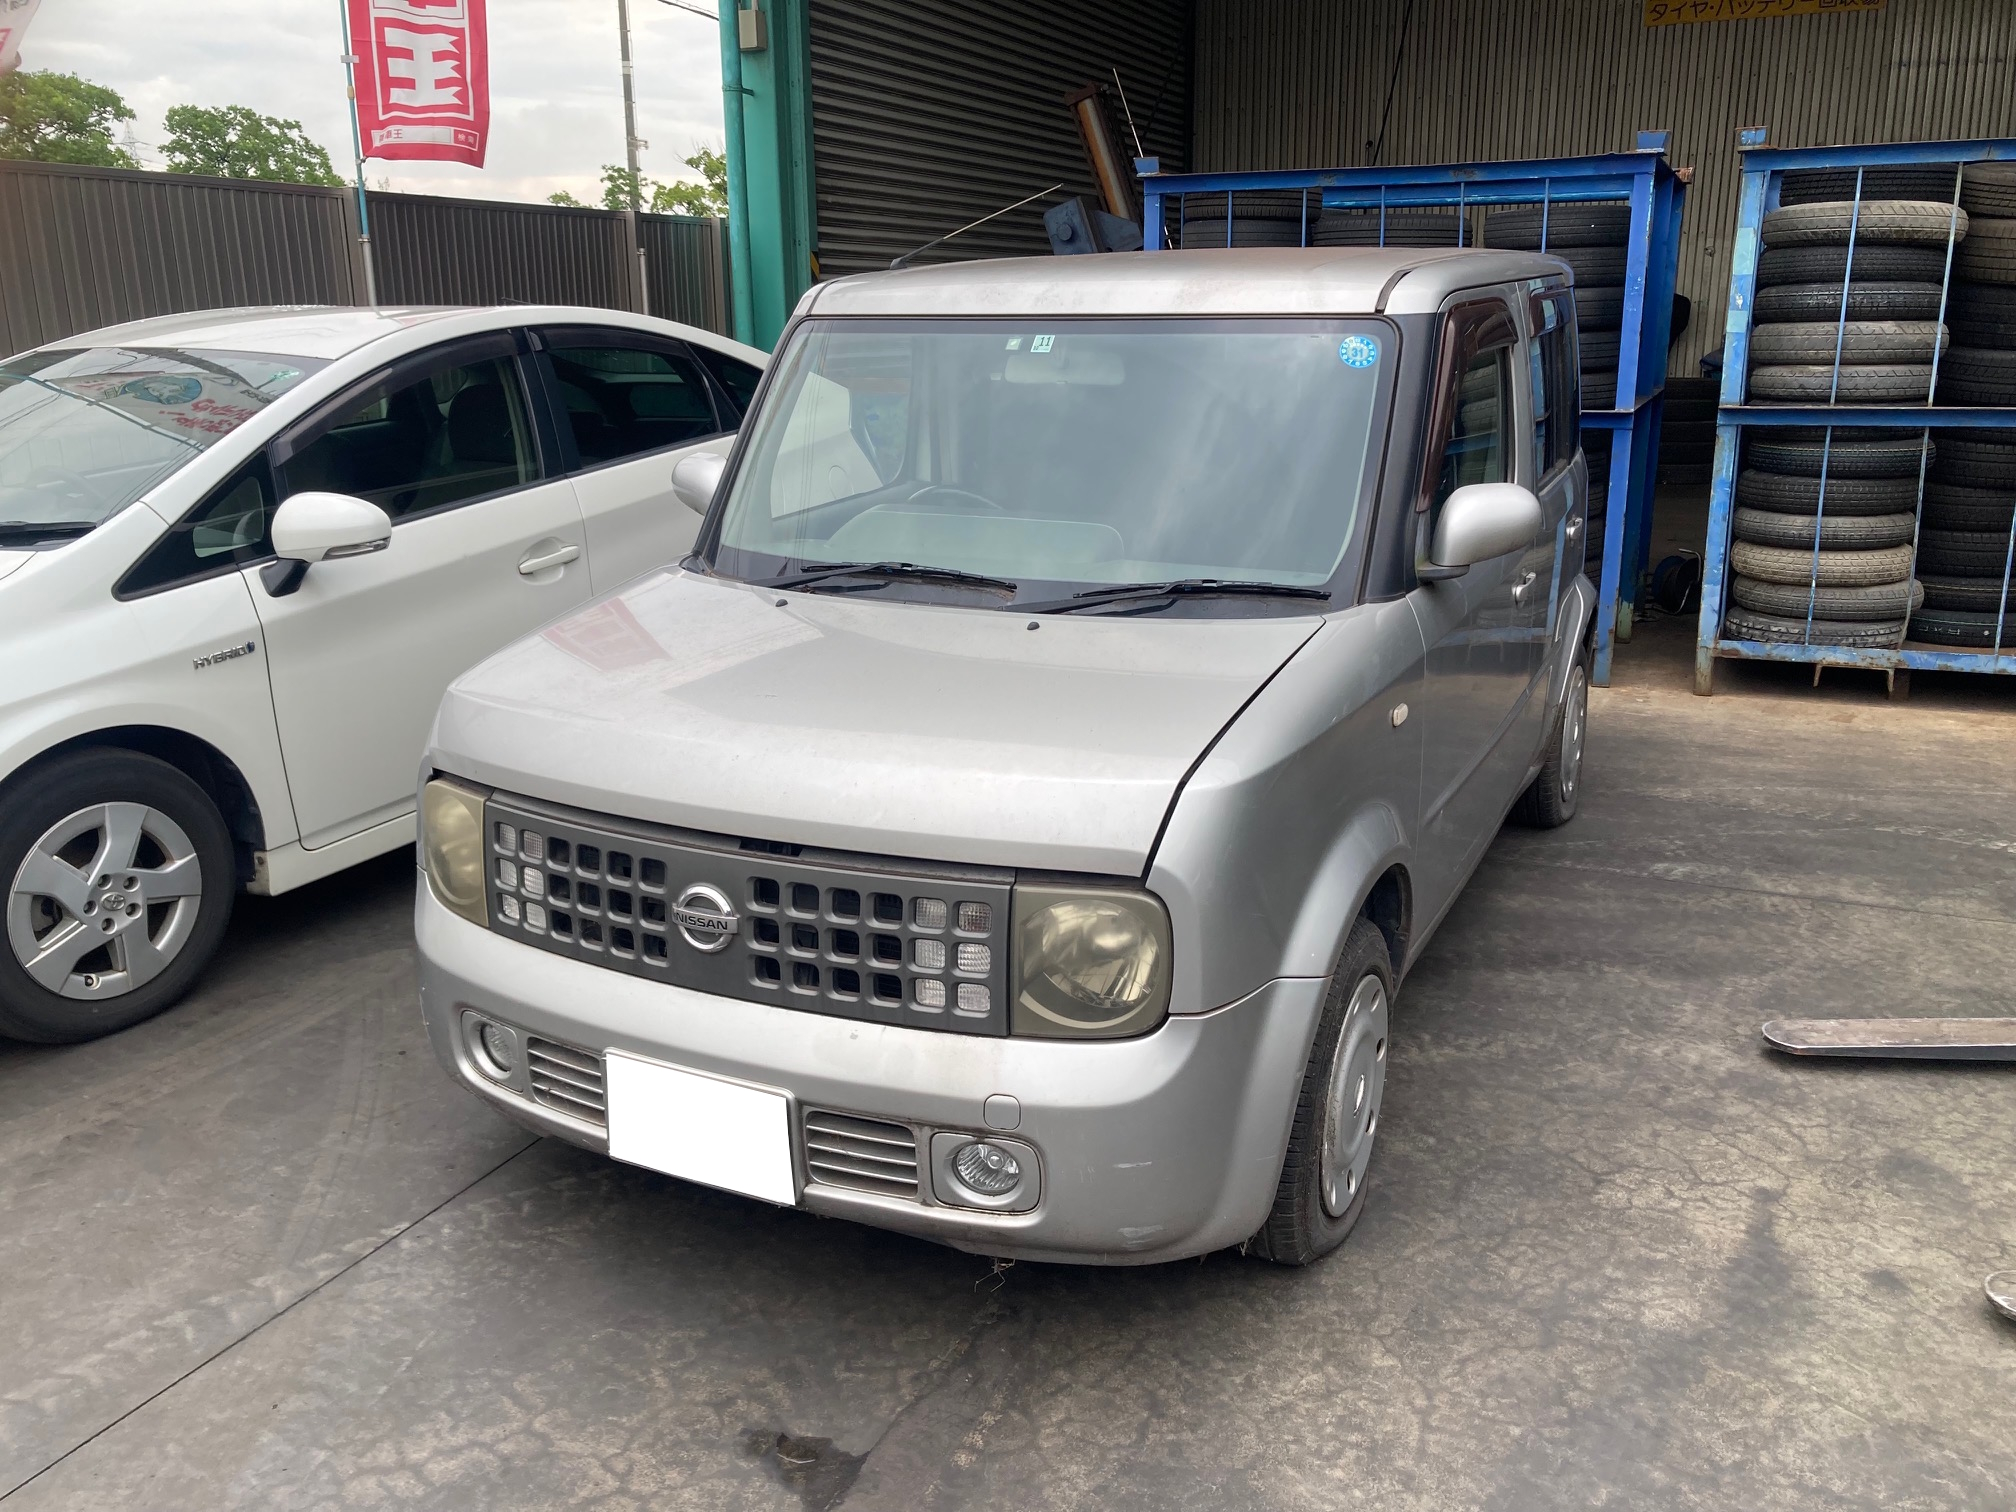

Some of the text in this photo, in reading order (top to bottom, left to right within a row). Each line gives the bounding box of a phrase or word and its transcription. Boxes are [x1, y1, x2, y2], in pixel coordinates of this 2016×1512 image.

[1038, 336, 1051, 347] 11
[1351, 347, 1364, 358] 31
[193, 645, 247, 670] HYBRID
[675, 912, 728, 931] NISSAN
